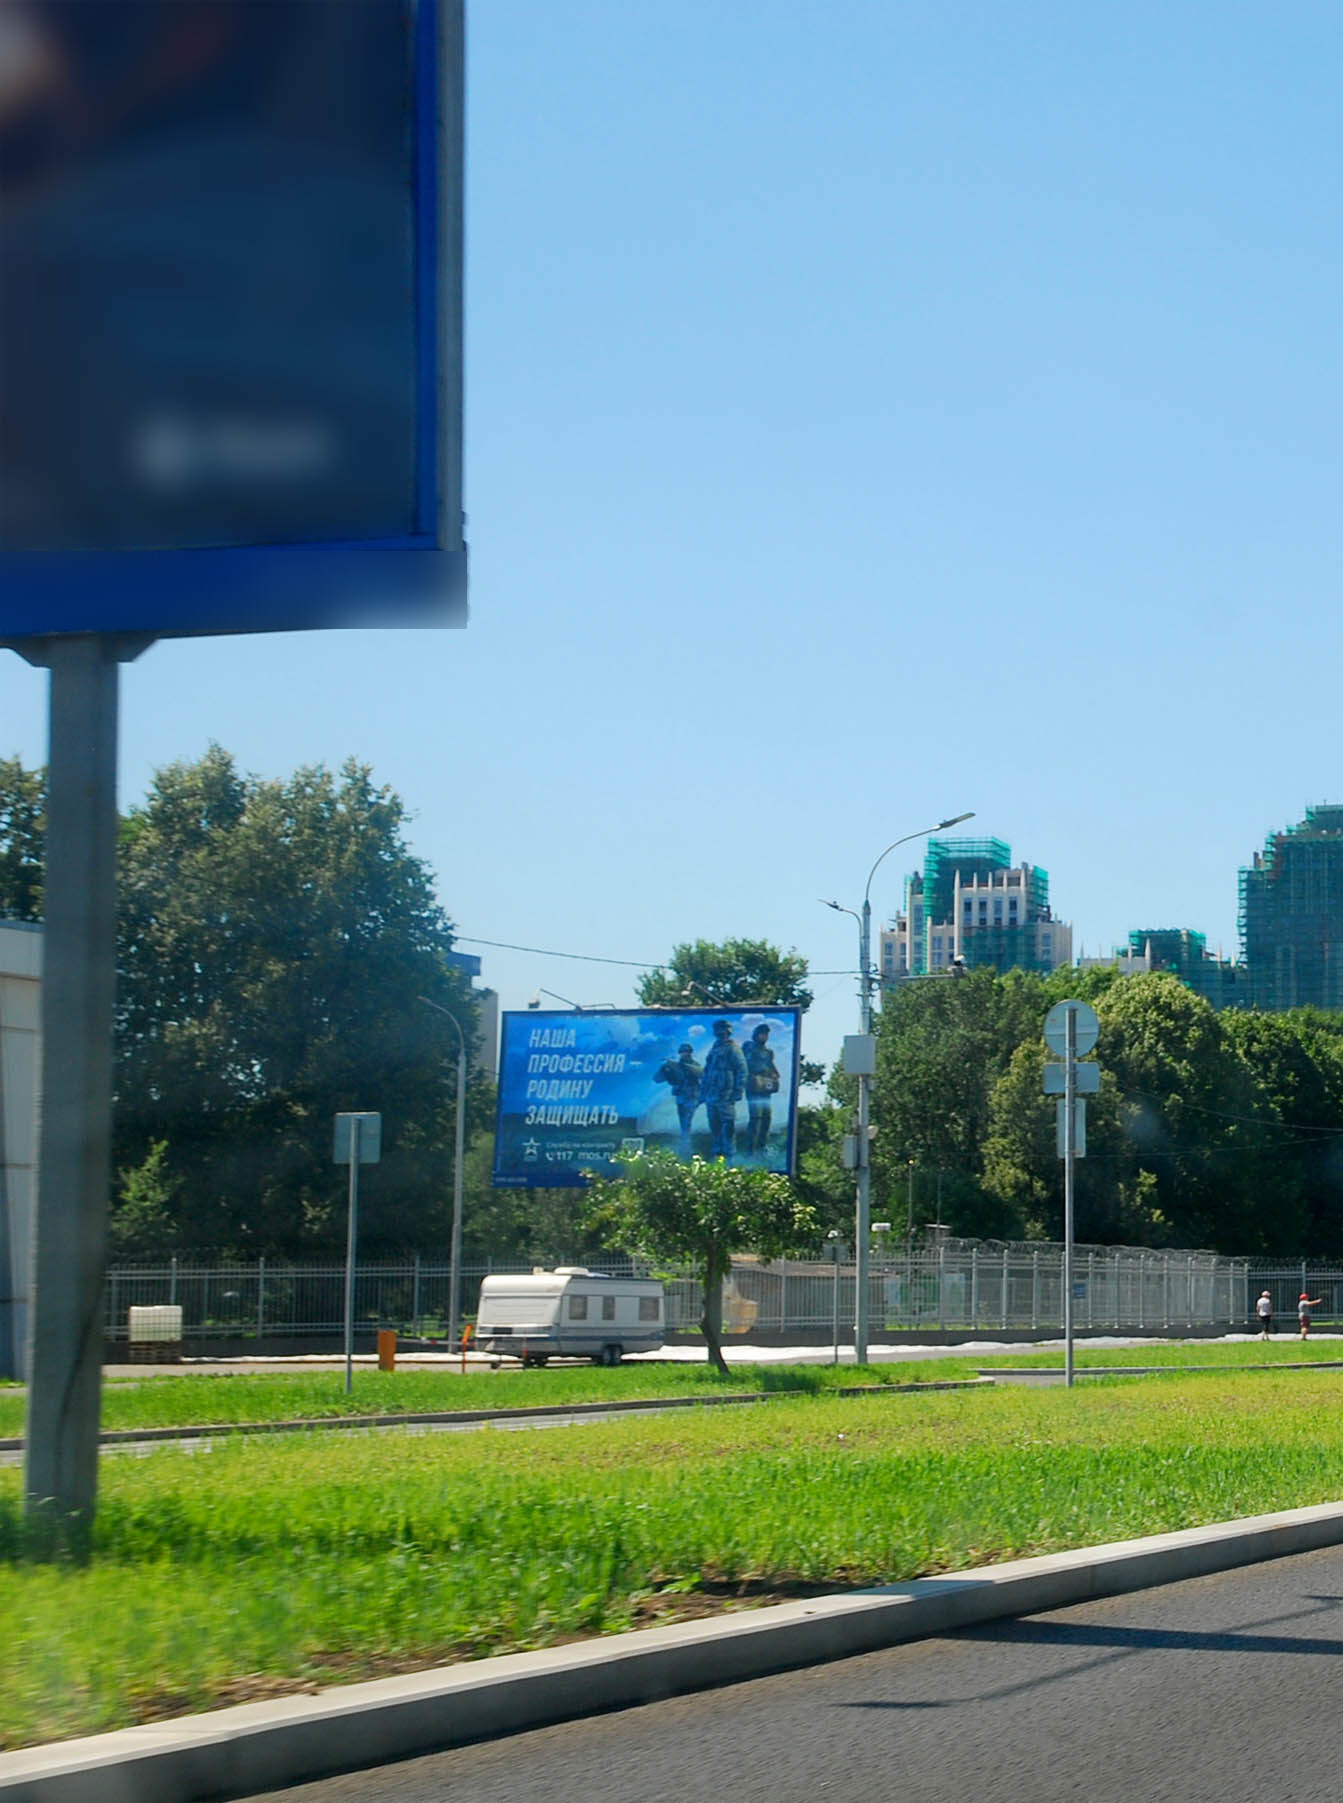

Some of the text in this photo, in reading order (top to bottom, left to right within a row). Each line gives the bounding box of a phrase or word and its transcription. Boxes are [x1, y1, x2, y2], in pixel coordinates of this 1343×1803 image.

[529, 1028, 576, 1048] НАША
[527, 1053, 626, 1073] ПРОФЕССИЯ
[526, 1079, 594, 1101] РОДИНУ
[525, 1104, 619, 1127] ЗАЩИЩАТЬ
[556, 1151, 574, 1161] 117
